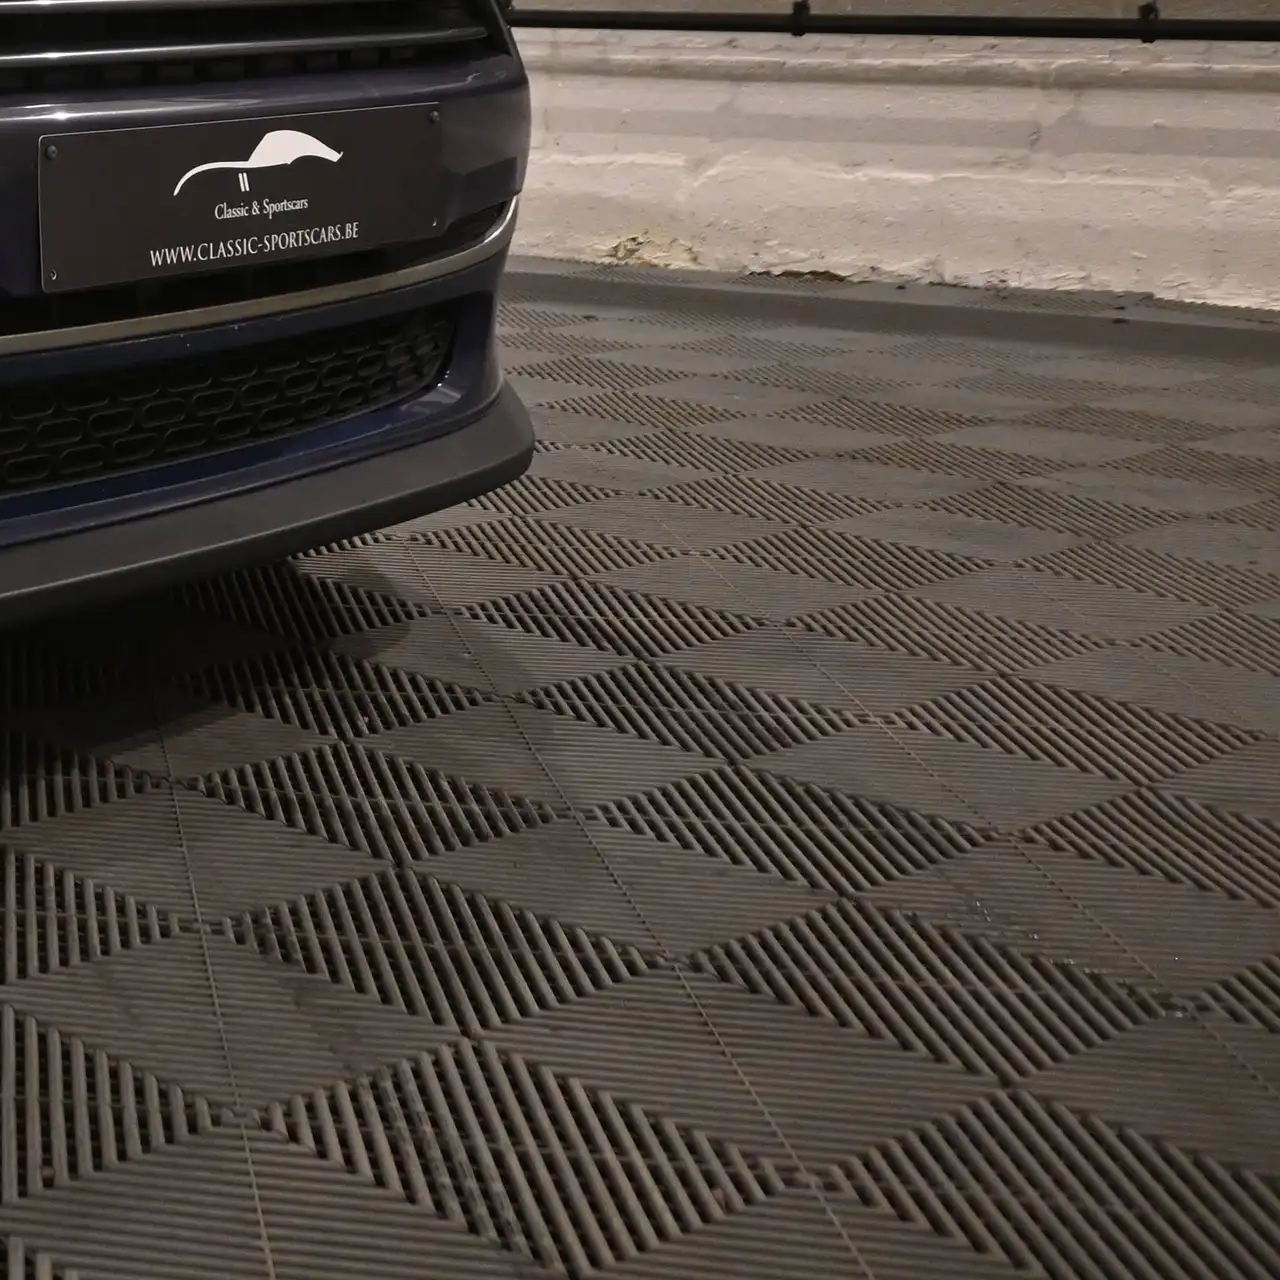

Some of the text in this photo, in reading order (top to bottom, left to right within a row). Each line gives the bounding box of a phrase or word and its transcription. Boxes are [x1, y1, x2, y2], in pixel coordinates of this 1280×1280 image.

[214, 197, 309, 220] Classic & Sportscars
[149, 221, 360, 267] WWW.CLASSIC-SPORTSCARS.BE
